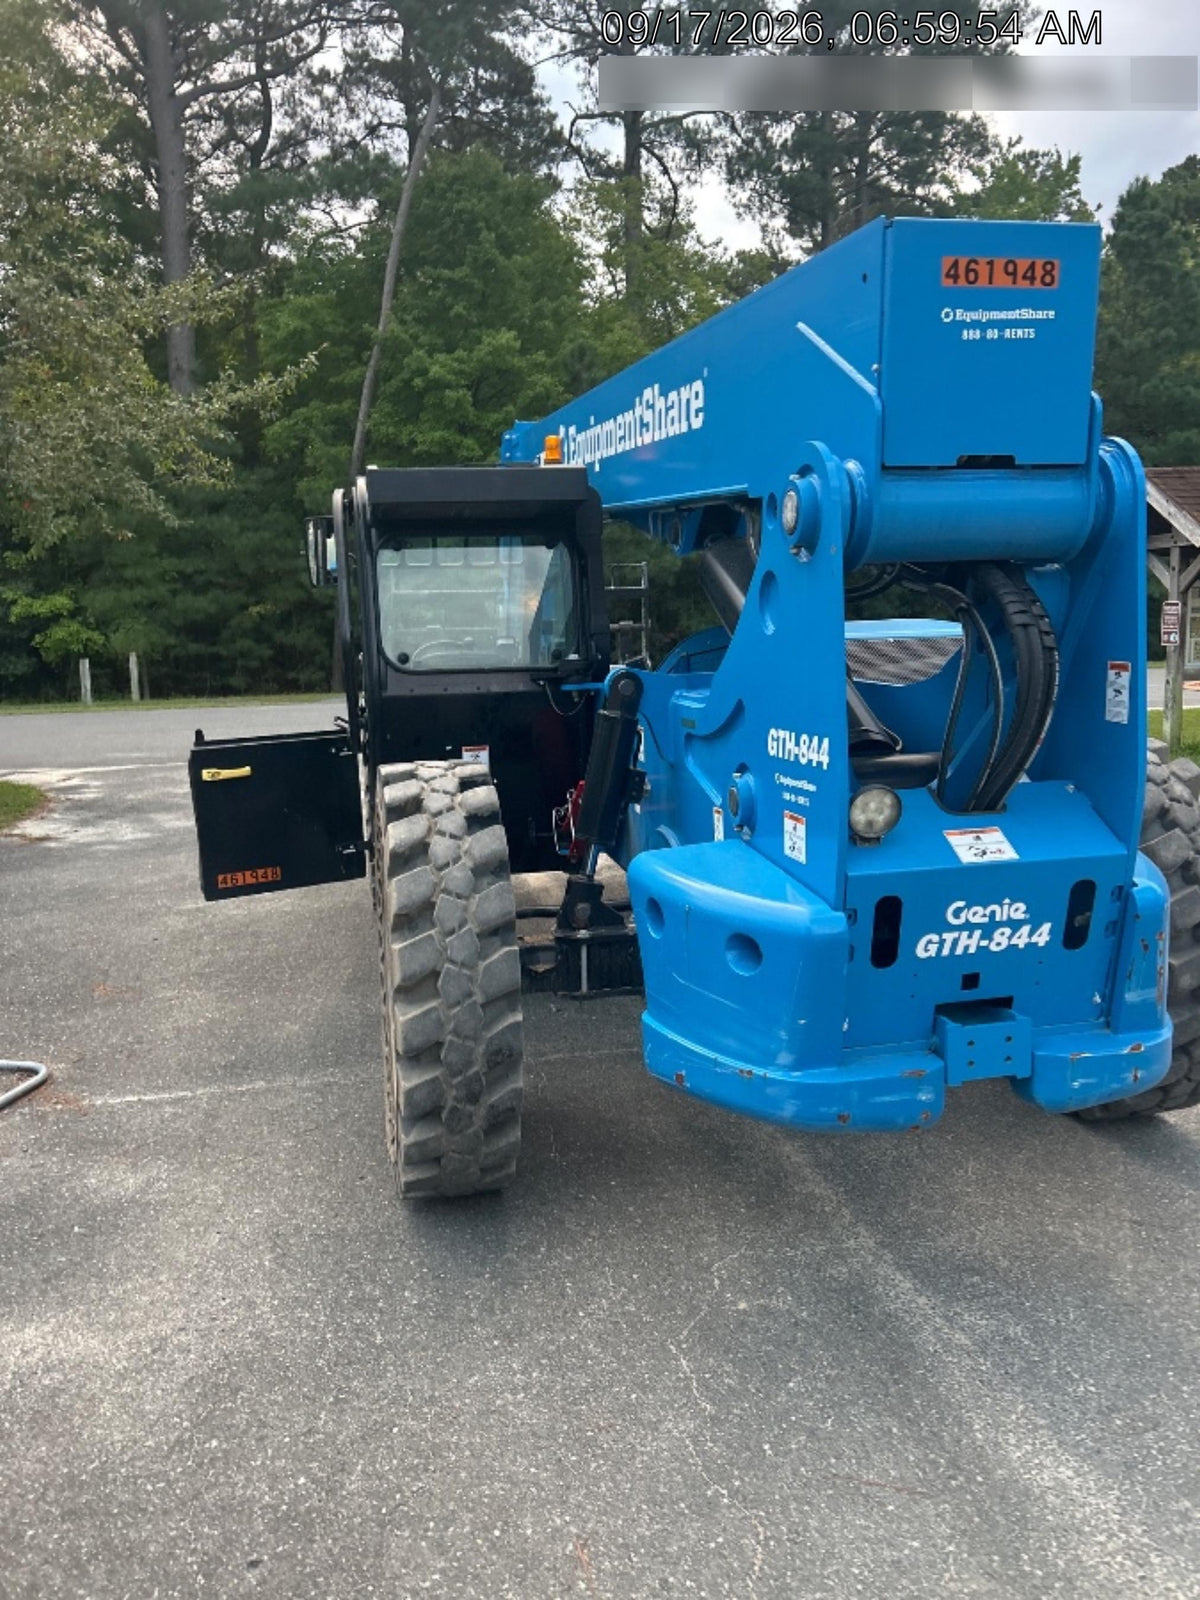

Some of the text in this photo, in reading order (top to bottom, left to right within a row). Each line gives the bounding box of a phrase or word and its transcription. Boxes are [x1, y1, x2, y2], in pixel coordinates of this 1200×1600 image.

[944, 258, 1056, 287] 461948
[955, 308, 1055, 322] EquipmentShare
[568, 378, 705, 472] EquipmentShare
[767, 727, 830, 771] GTH-844
[219, 867, 280, 887] 461948
[945, 897, 1027, 926] Genie
[915, 922, 1053, 960] GTH-844
